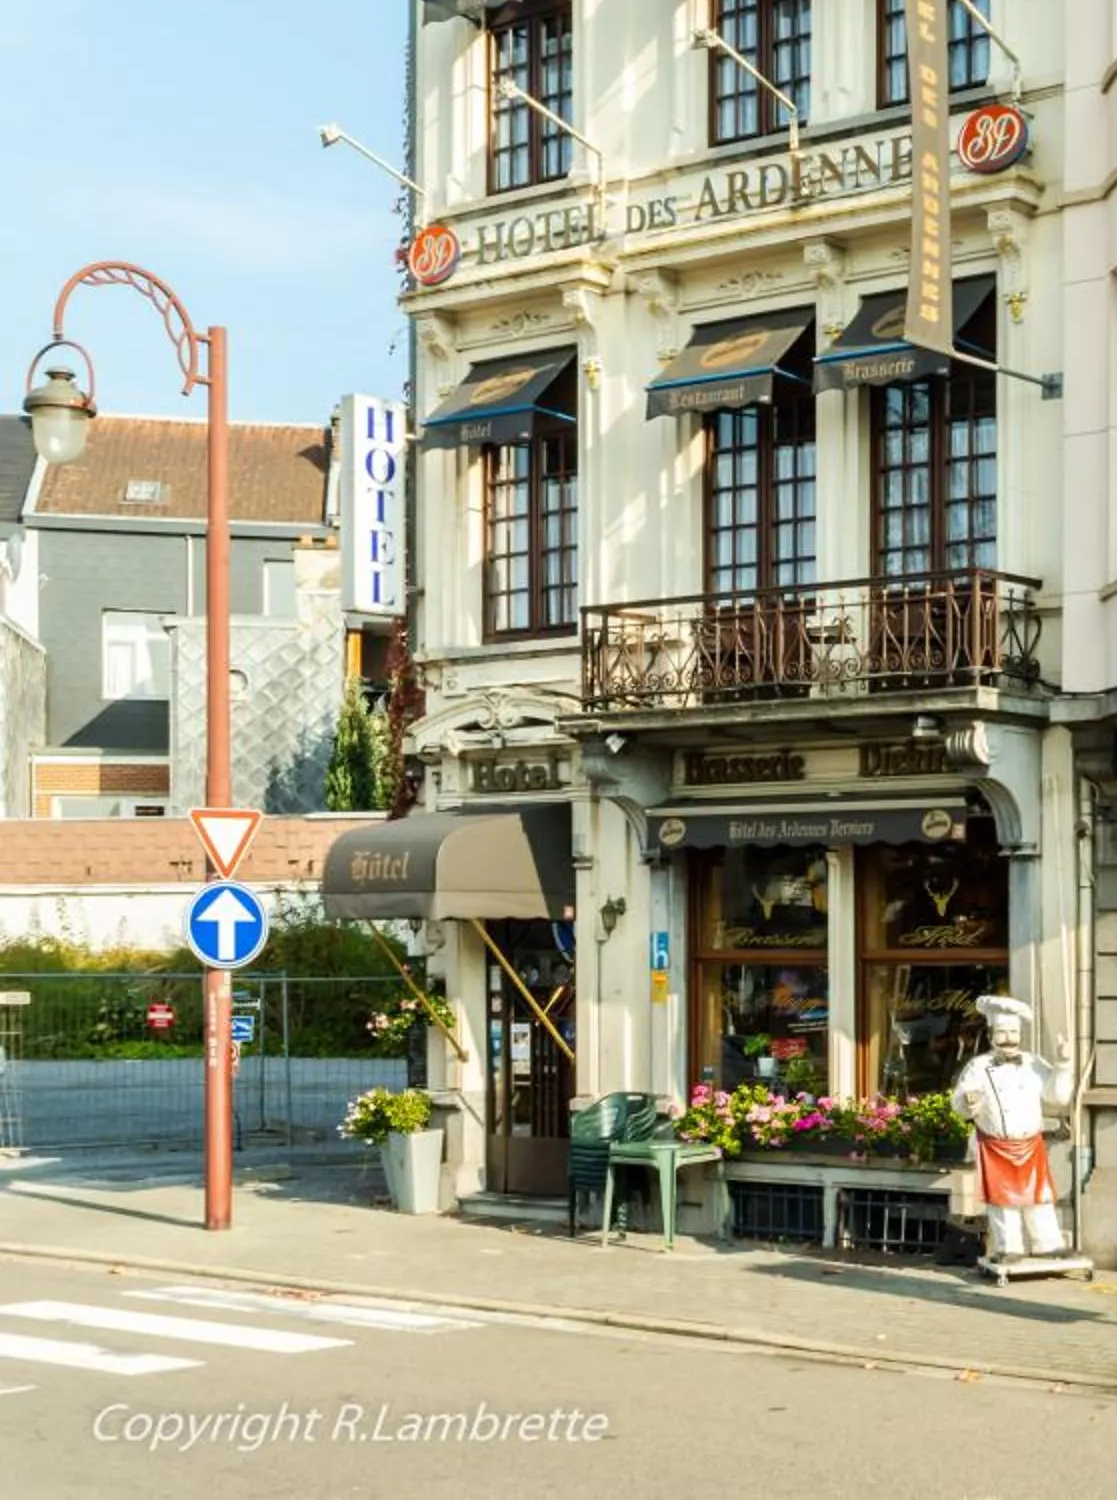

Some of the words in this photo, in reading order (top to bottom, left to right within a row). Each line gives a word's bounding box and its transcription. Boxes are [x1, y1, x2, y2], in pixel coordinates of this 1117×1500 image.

[477, 202, 606, 266] HOTEL
[625, 196, 679, 234] DES
[694, 134, 913, 223] ARDENNE
[841, 357, 917, 380] Brasserie
[365, 407, 396, 606] HOTEL
[472, 750, 564, 793] Hotel
[684, 750, 805, 785] Brasserie
[351, 851, 410, 885] Hôtel
